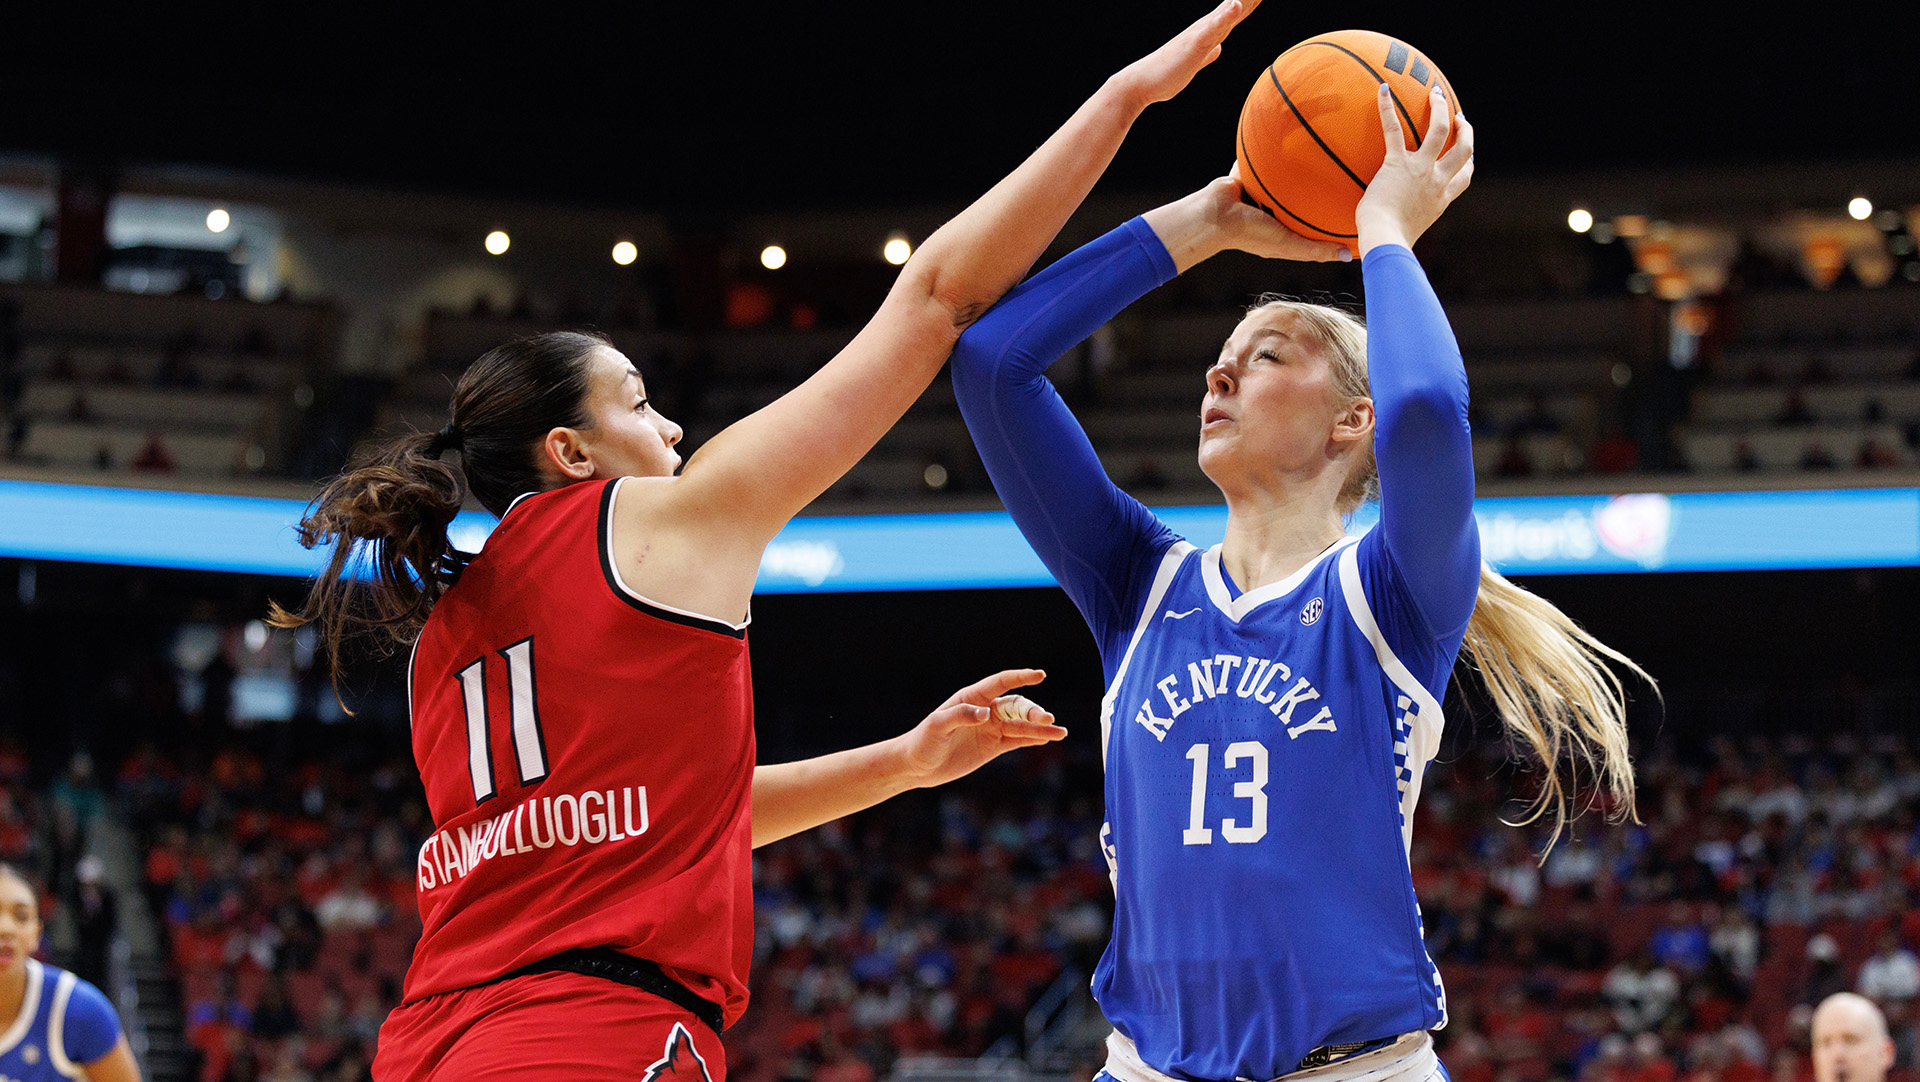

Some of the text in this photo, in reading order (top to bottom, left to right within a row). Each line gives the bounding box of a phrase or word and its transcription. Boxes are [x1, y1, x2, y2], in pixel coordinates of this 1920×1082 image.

[1301, 599, 1322, 624] SEC
[454, 635, 550, 807] 11
[1135, 654, 1337, 742] KENTUCKY
[417, 786, 650, 893] ISTANBULLUOGLU
[1183, 741, 1269, 845] 13
